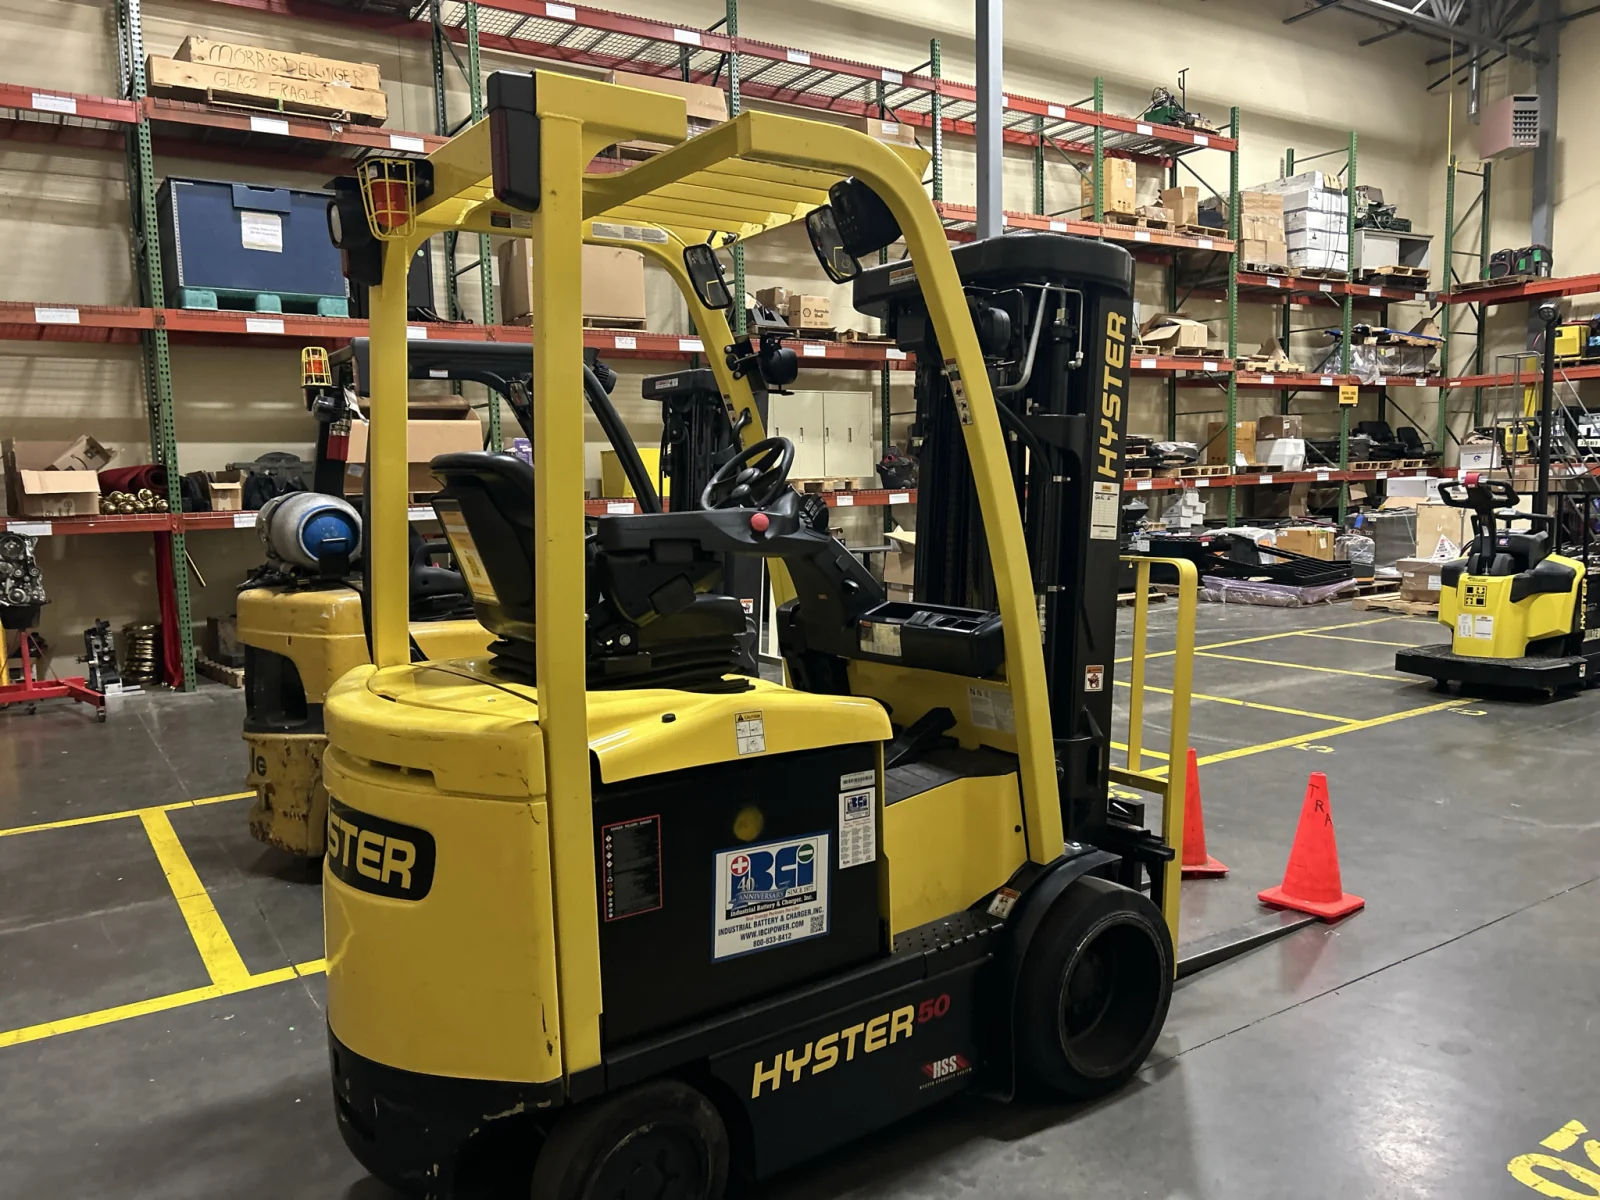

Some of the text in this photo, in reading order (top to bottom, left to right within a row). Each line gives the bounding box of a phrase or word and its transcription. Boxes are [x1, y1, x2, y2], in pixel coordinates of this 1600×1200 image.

[214, 72, 258, 89] GLASS
[1098, 311, 1127, 478] HYSTER
[328, 811, 417, 890] STER
[736, 876, 756, 892] 40
[787, 888, 803, 896] SINCE
[738, 890, 784, 901] ANNIVERSARY
[730, 906, 756, 917] Industrial
[757, 902, 775, 912] Battery
[718, 920, 752, 936] INDUSTRIAL
[754, 916, 778, 929] BATTERY
[780, 914, 784, 922] &
[740, 919, 804, 941] WWW.IBCIPOWER.COM
[753, 932, 792, 947] 800-833-8412
[917, 993, 950, 1024] 50
[751, 1004, 915, 1099] HYSTER
[932, 1055, 957, 1079] HSS
